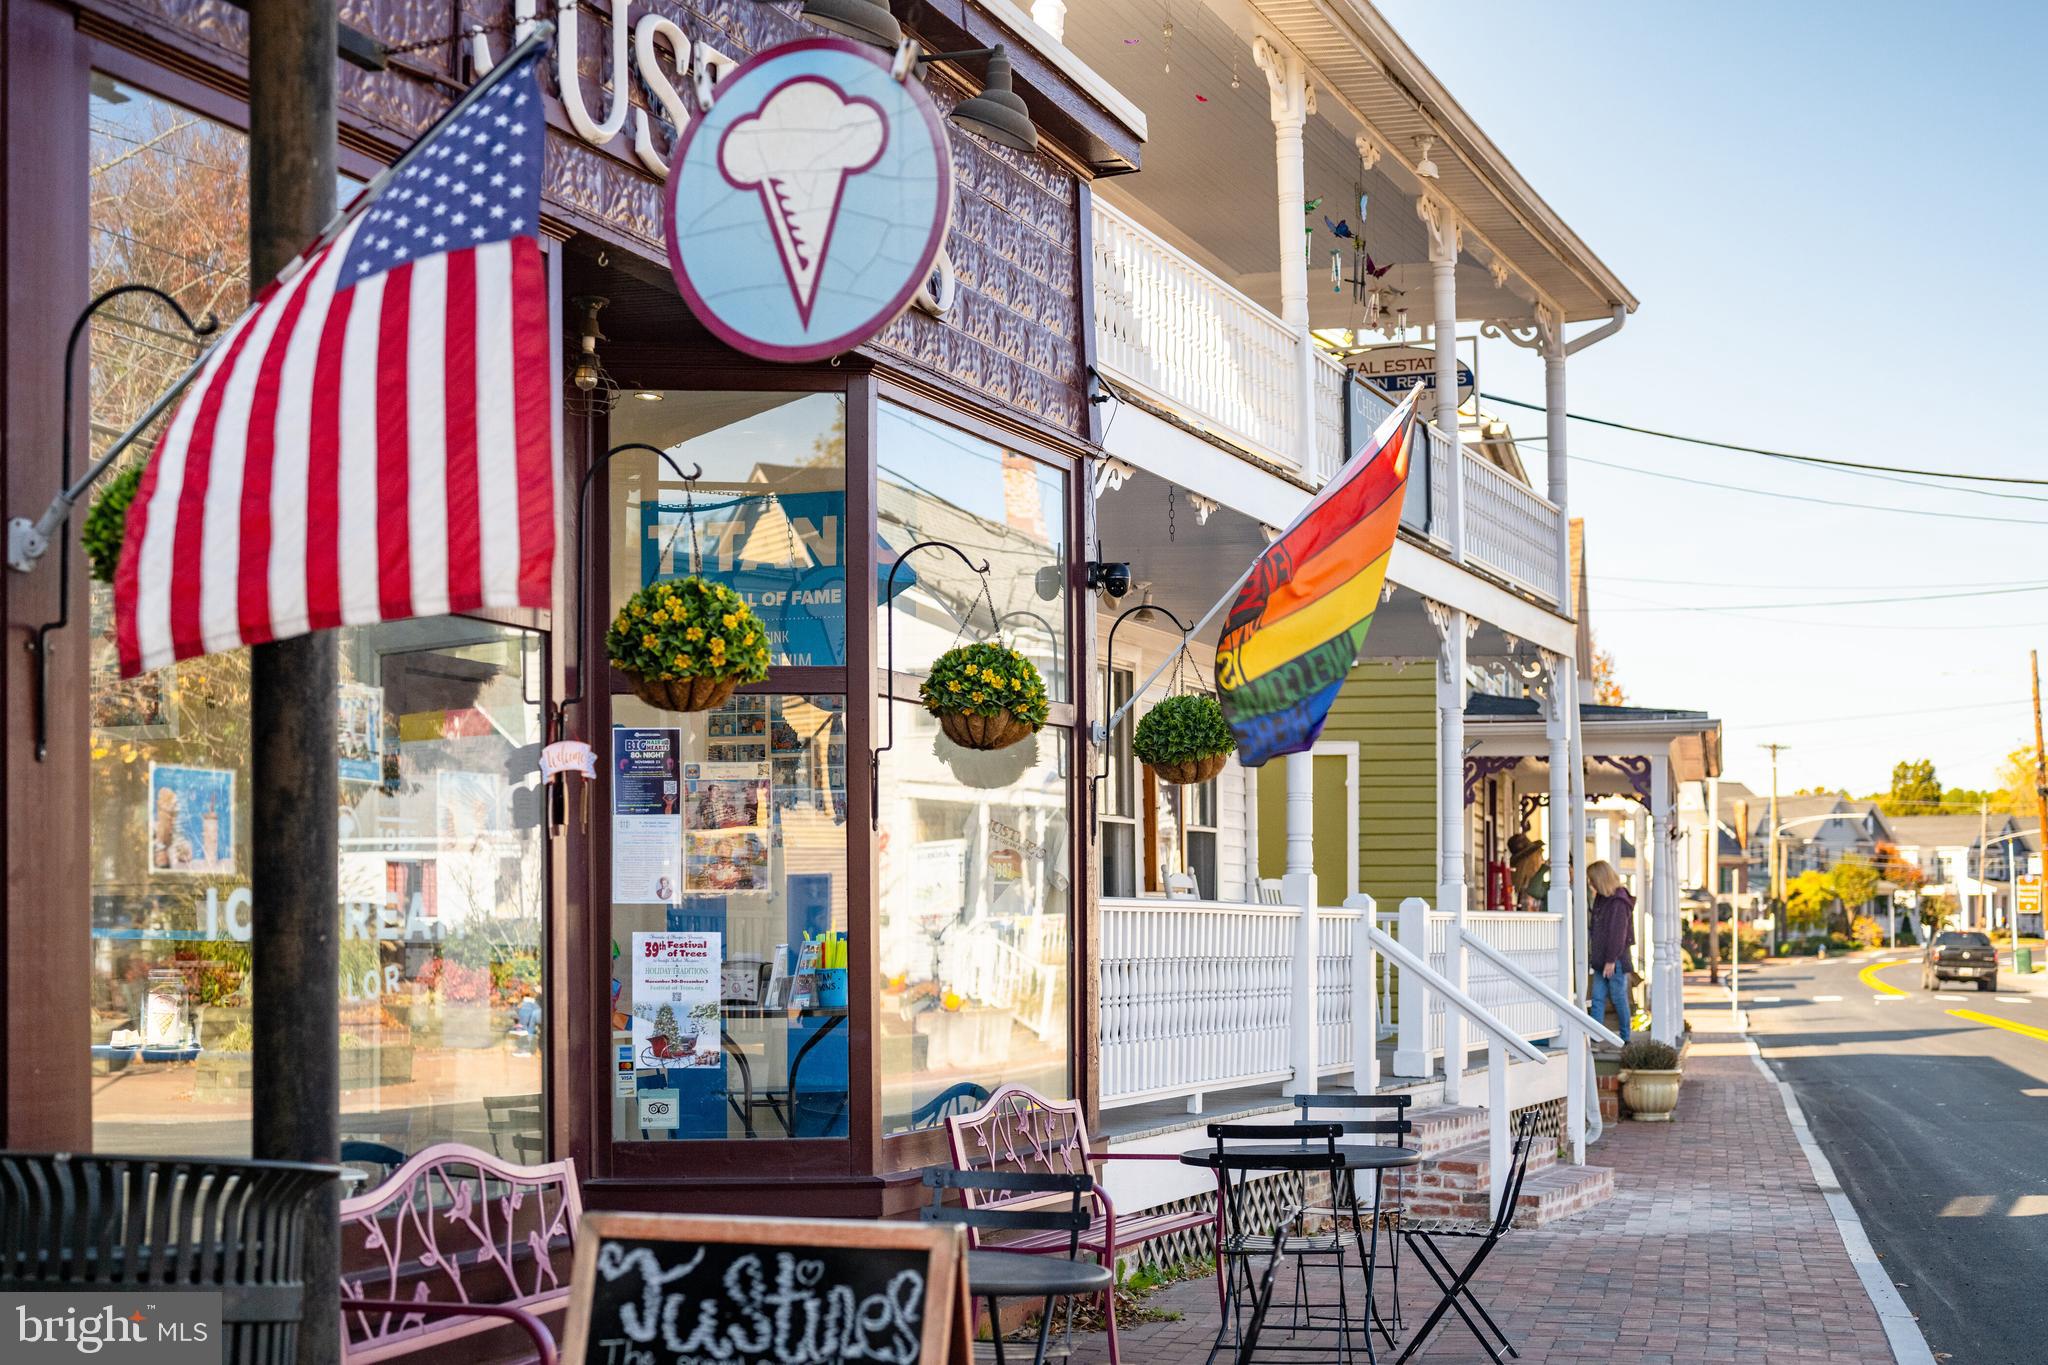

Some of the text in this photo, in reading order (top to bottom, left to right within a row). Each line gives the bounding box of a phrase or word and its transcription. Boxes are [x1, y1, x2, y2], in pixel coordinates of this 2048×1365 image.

[1385, 357, 1435, 373] ESTAT
[761, 591, 787, 606] OF
[791, 588, 841, 605] FAME
[627, 740, 646, 750] BIG
[206, 887, 253, 942] IC
[645, 940, 708, 957] 39th Festival
[645, 967, 709, 975] HOLIDAY TRADITIONS
